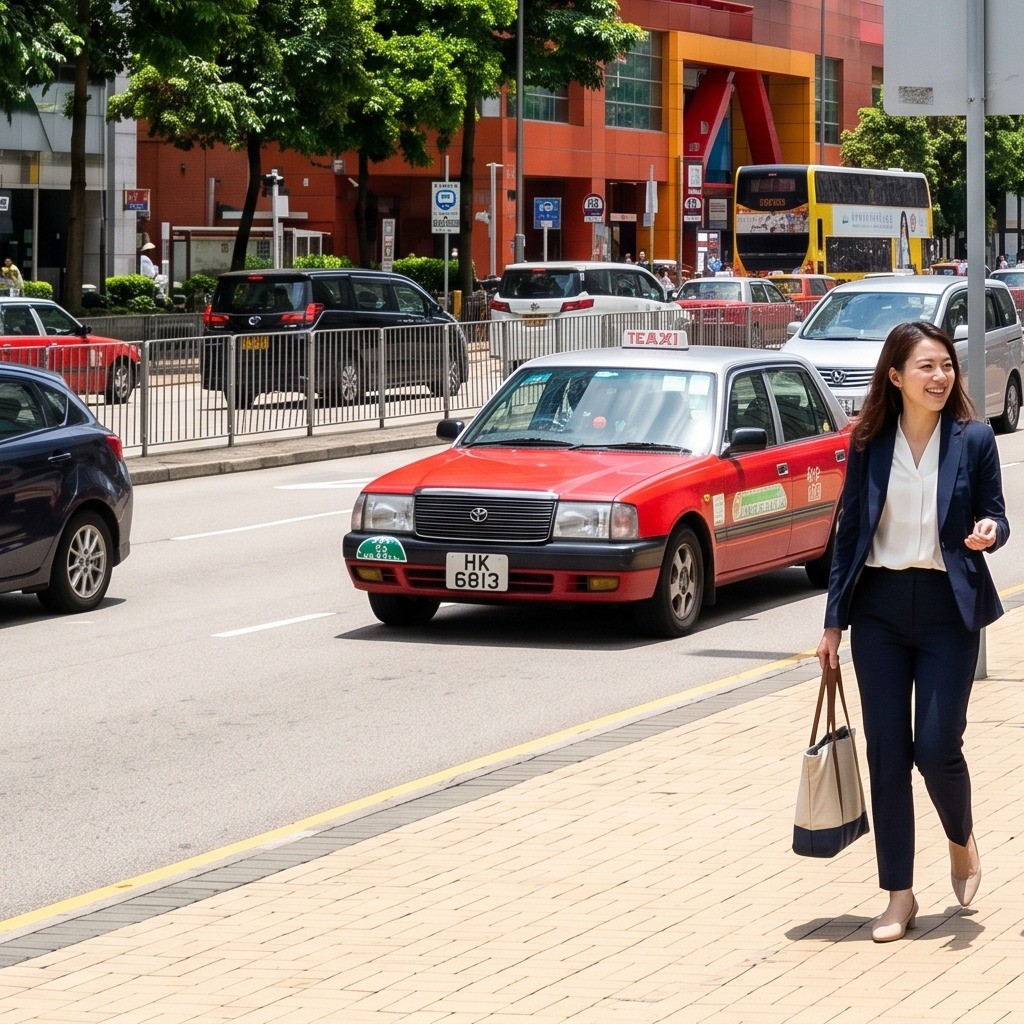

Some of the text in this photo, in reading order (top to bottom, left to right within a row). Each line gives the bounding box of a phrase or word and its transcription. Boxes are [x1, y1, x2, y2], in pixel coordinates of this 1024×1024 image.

[627, 332, 679, 346] TEAXI
[464, 554, 490, 571] HK
[454, 571, 500, 589] 6813
